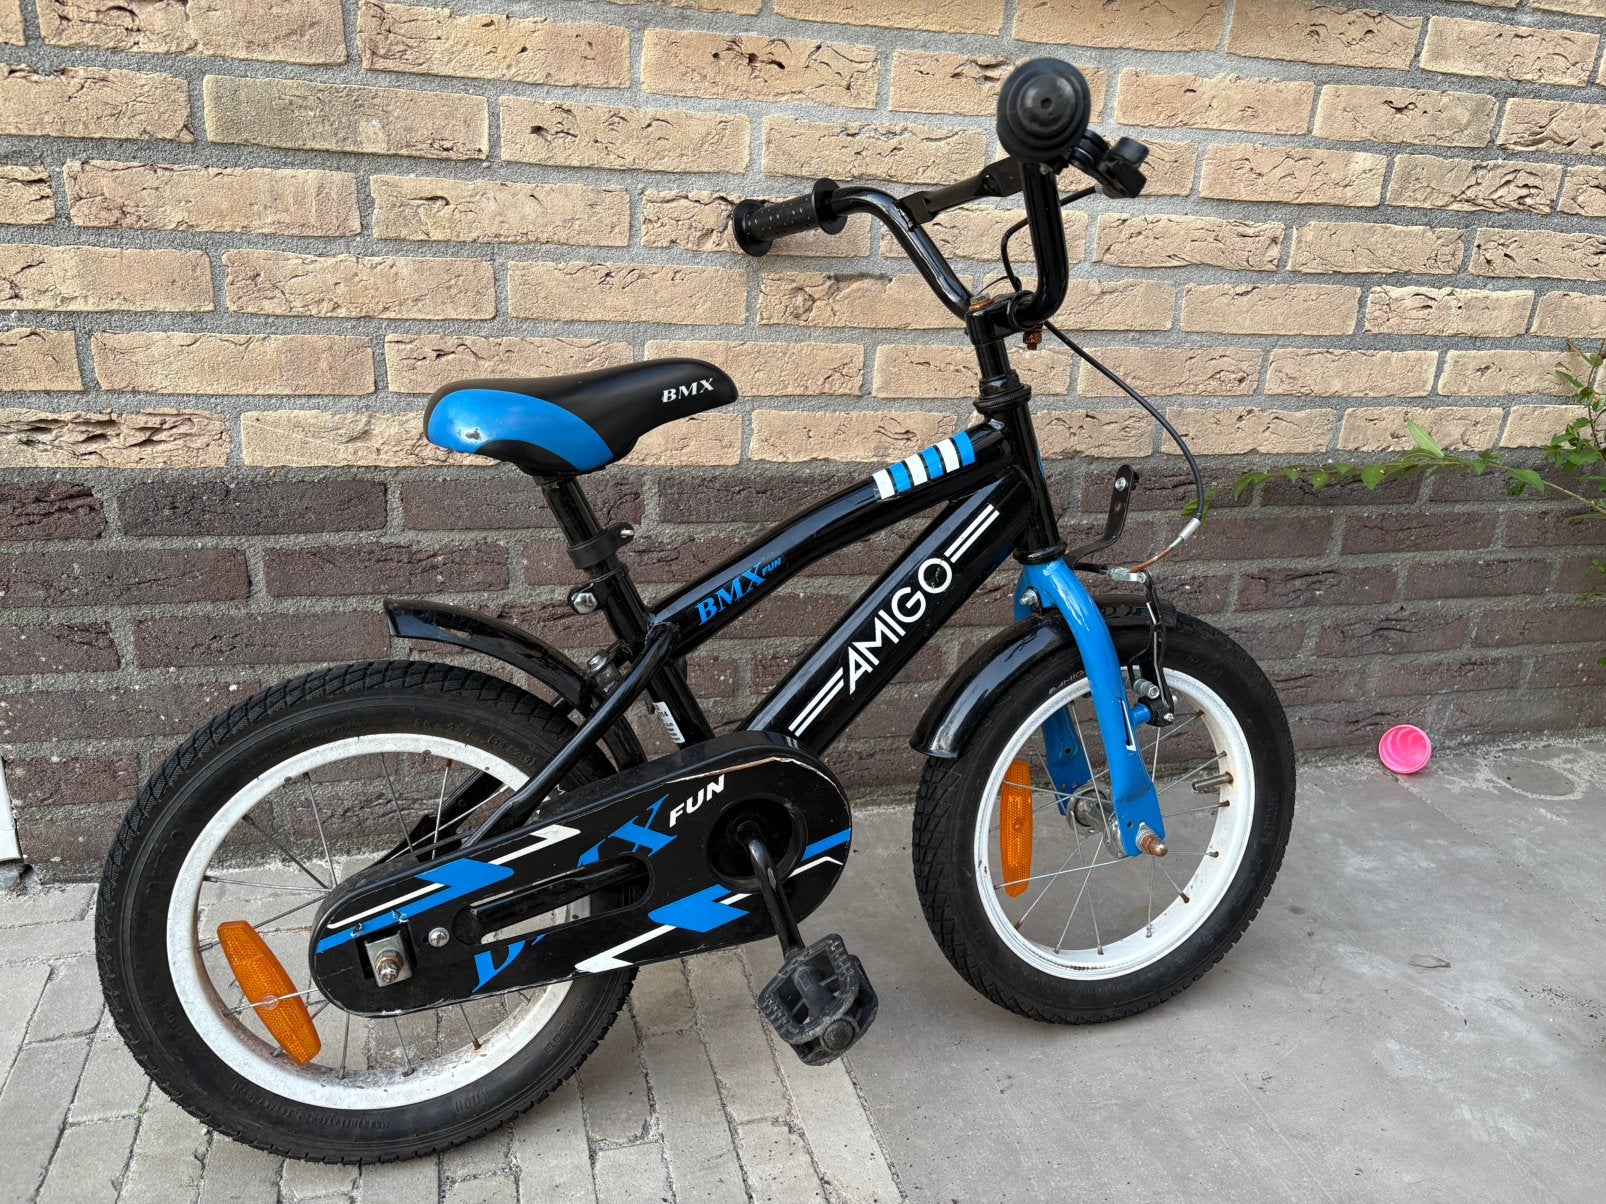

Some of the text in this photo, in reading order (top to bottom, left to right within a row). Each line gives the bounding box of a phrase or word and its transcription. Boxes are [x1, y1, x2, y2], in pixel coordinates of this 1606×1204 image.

[661, 377, 714, 403] BMX
[695, 557, 782, 626] BMX FUN
[848, 557, 953, 696] AMIGO
[669, 774, 725, 829] FUN
